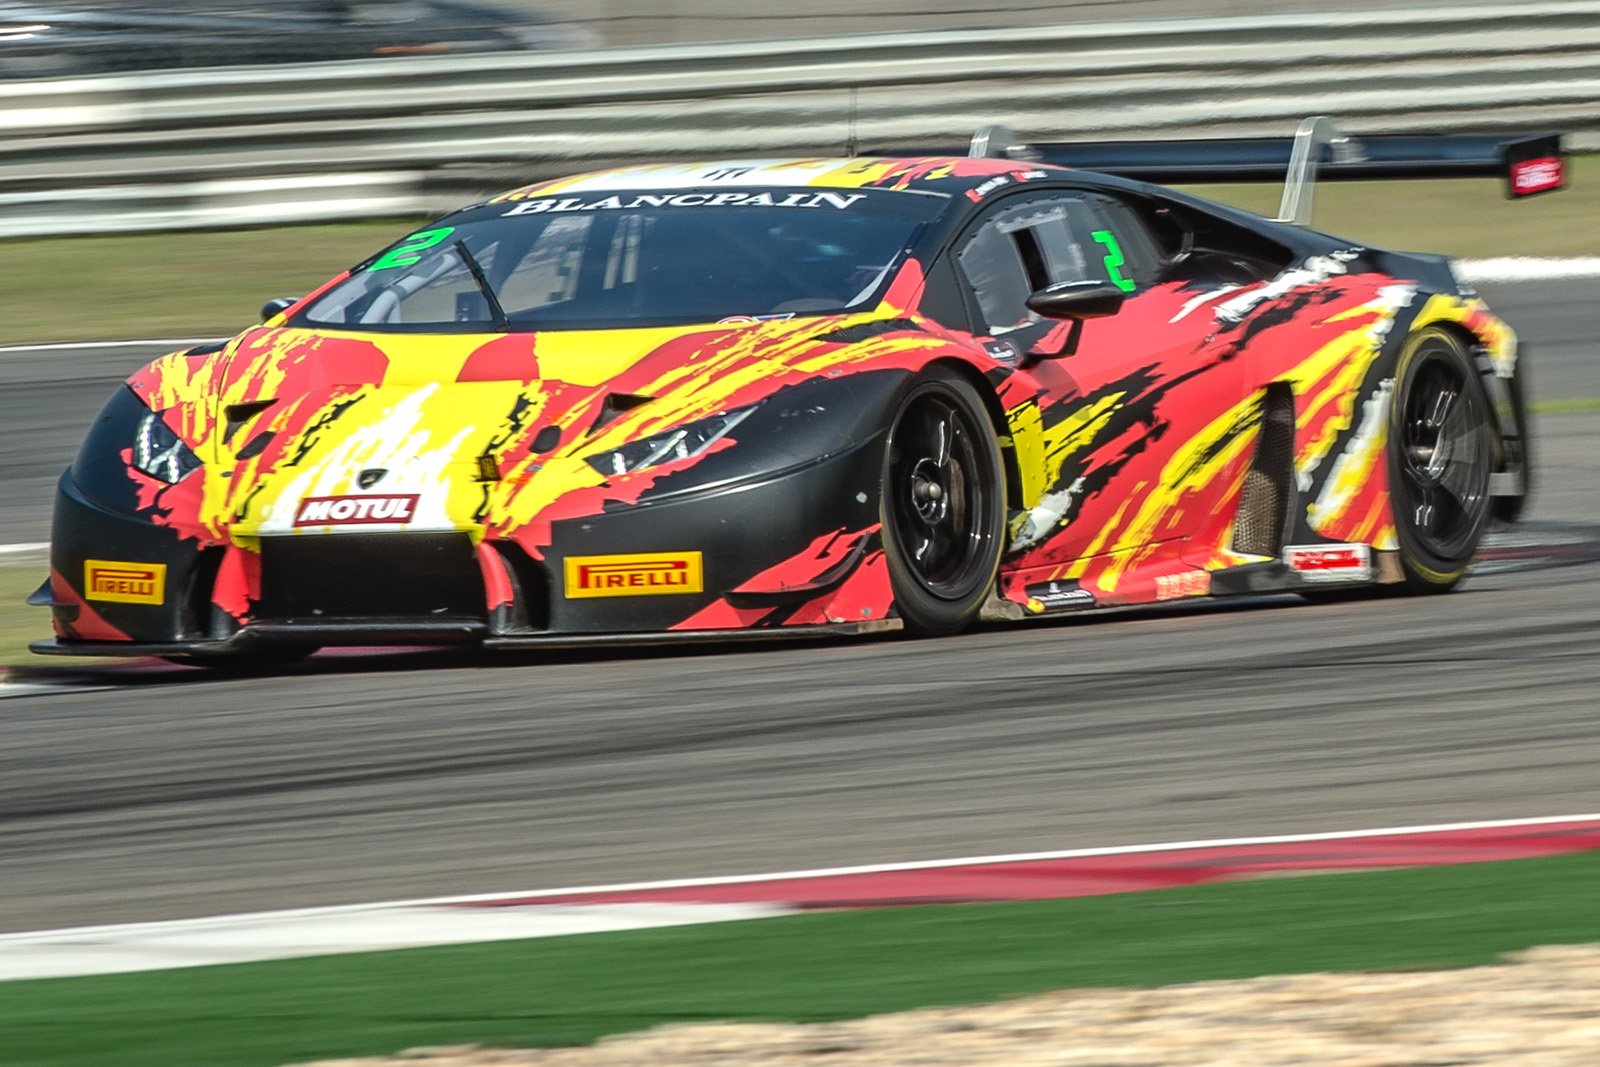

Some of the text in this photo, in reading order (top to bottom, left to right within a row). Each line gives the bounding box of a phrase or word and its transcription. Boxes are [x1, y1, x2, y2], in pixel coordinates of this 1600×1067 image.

[500, 191, 868, 217] BLANCPAIN
[366, 226, 456, 273] 2
[1091, 230, 1136, 292] 2
[298, 498, 412, 522] MOTUL
[91, 568, 155, 595] PIRELLI
[578, 560, 688, 589] PIRELLI
